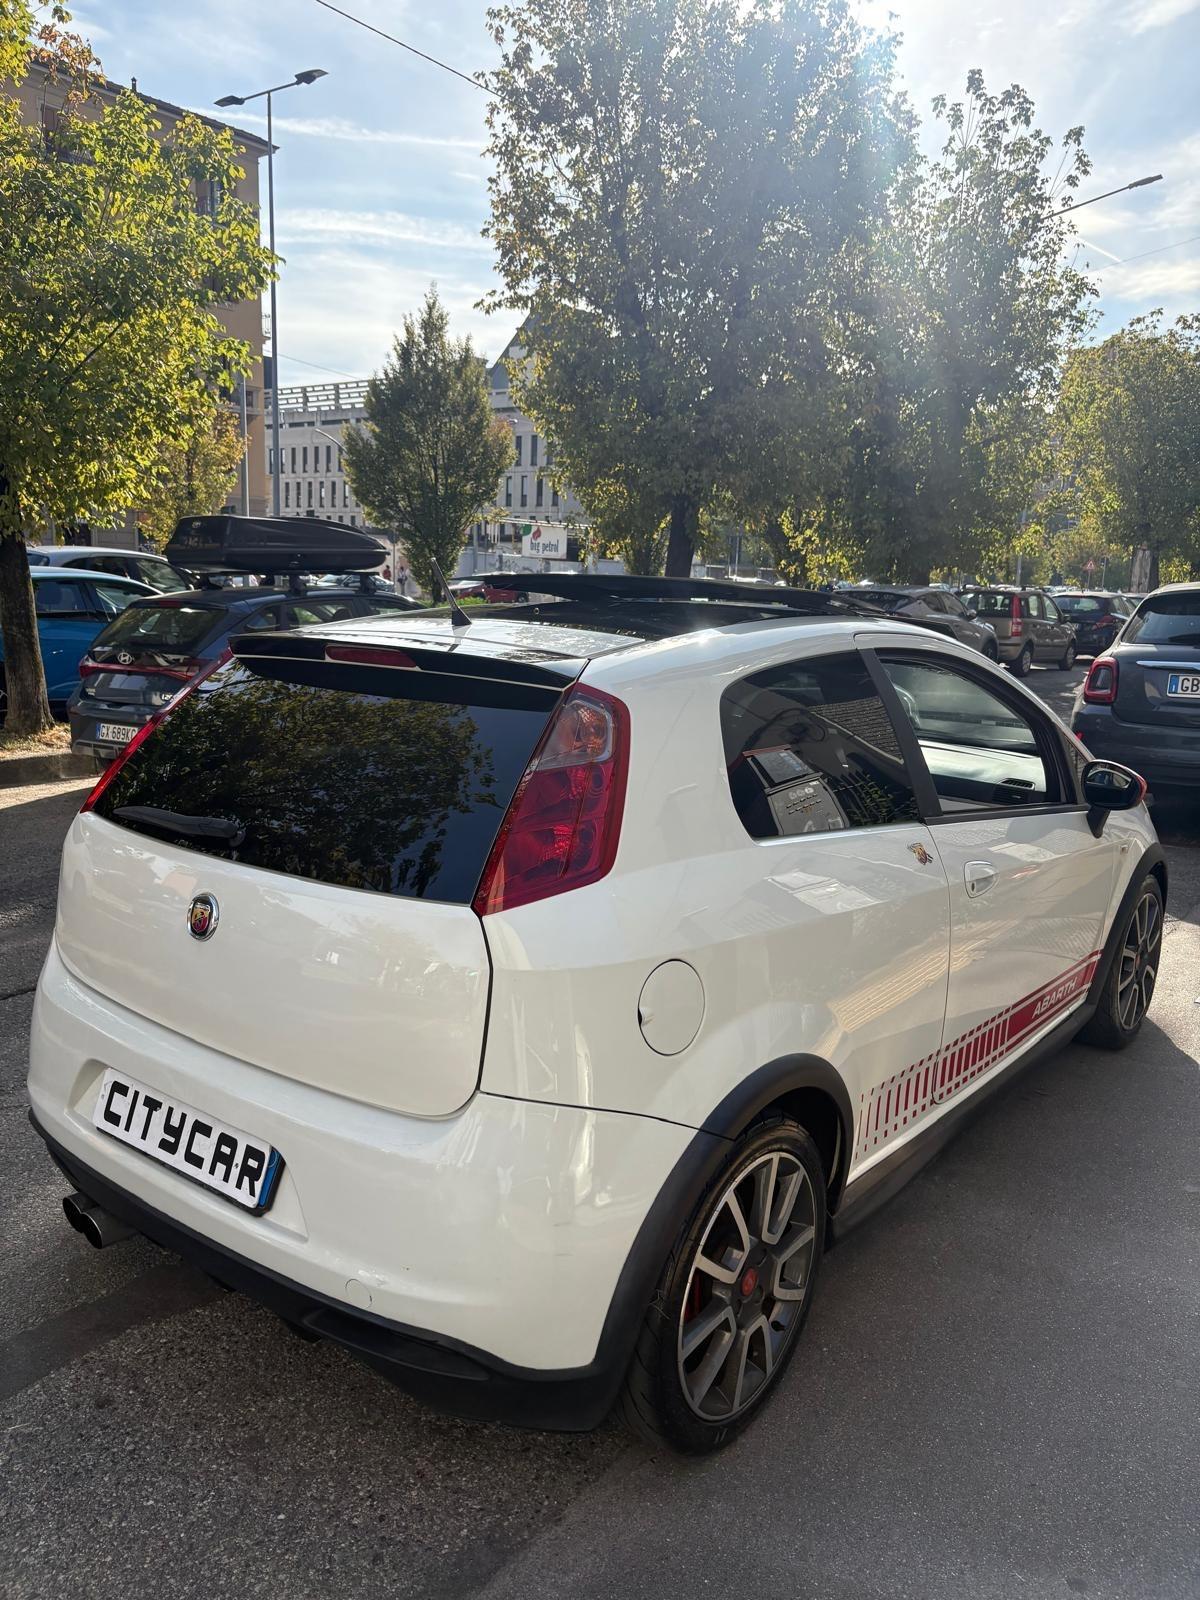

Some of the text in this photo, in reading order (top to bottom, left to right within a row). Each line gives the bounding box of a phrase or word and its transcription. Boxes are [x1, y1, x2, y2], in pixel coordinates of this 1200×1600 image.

[530, 537, 559, 554] big petrol
[1180, 677, 1200, 693] GB
[1031, 976, 1078, 1019] ABARTH
[103, 1080, 266, 1198] CITYCAR
